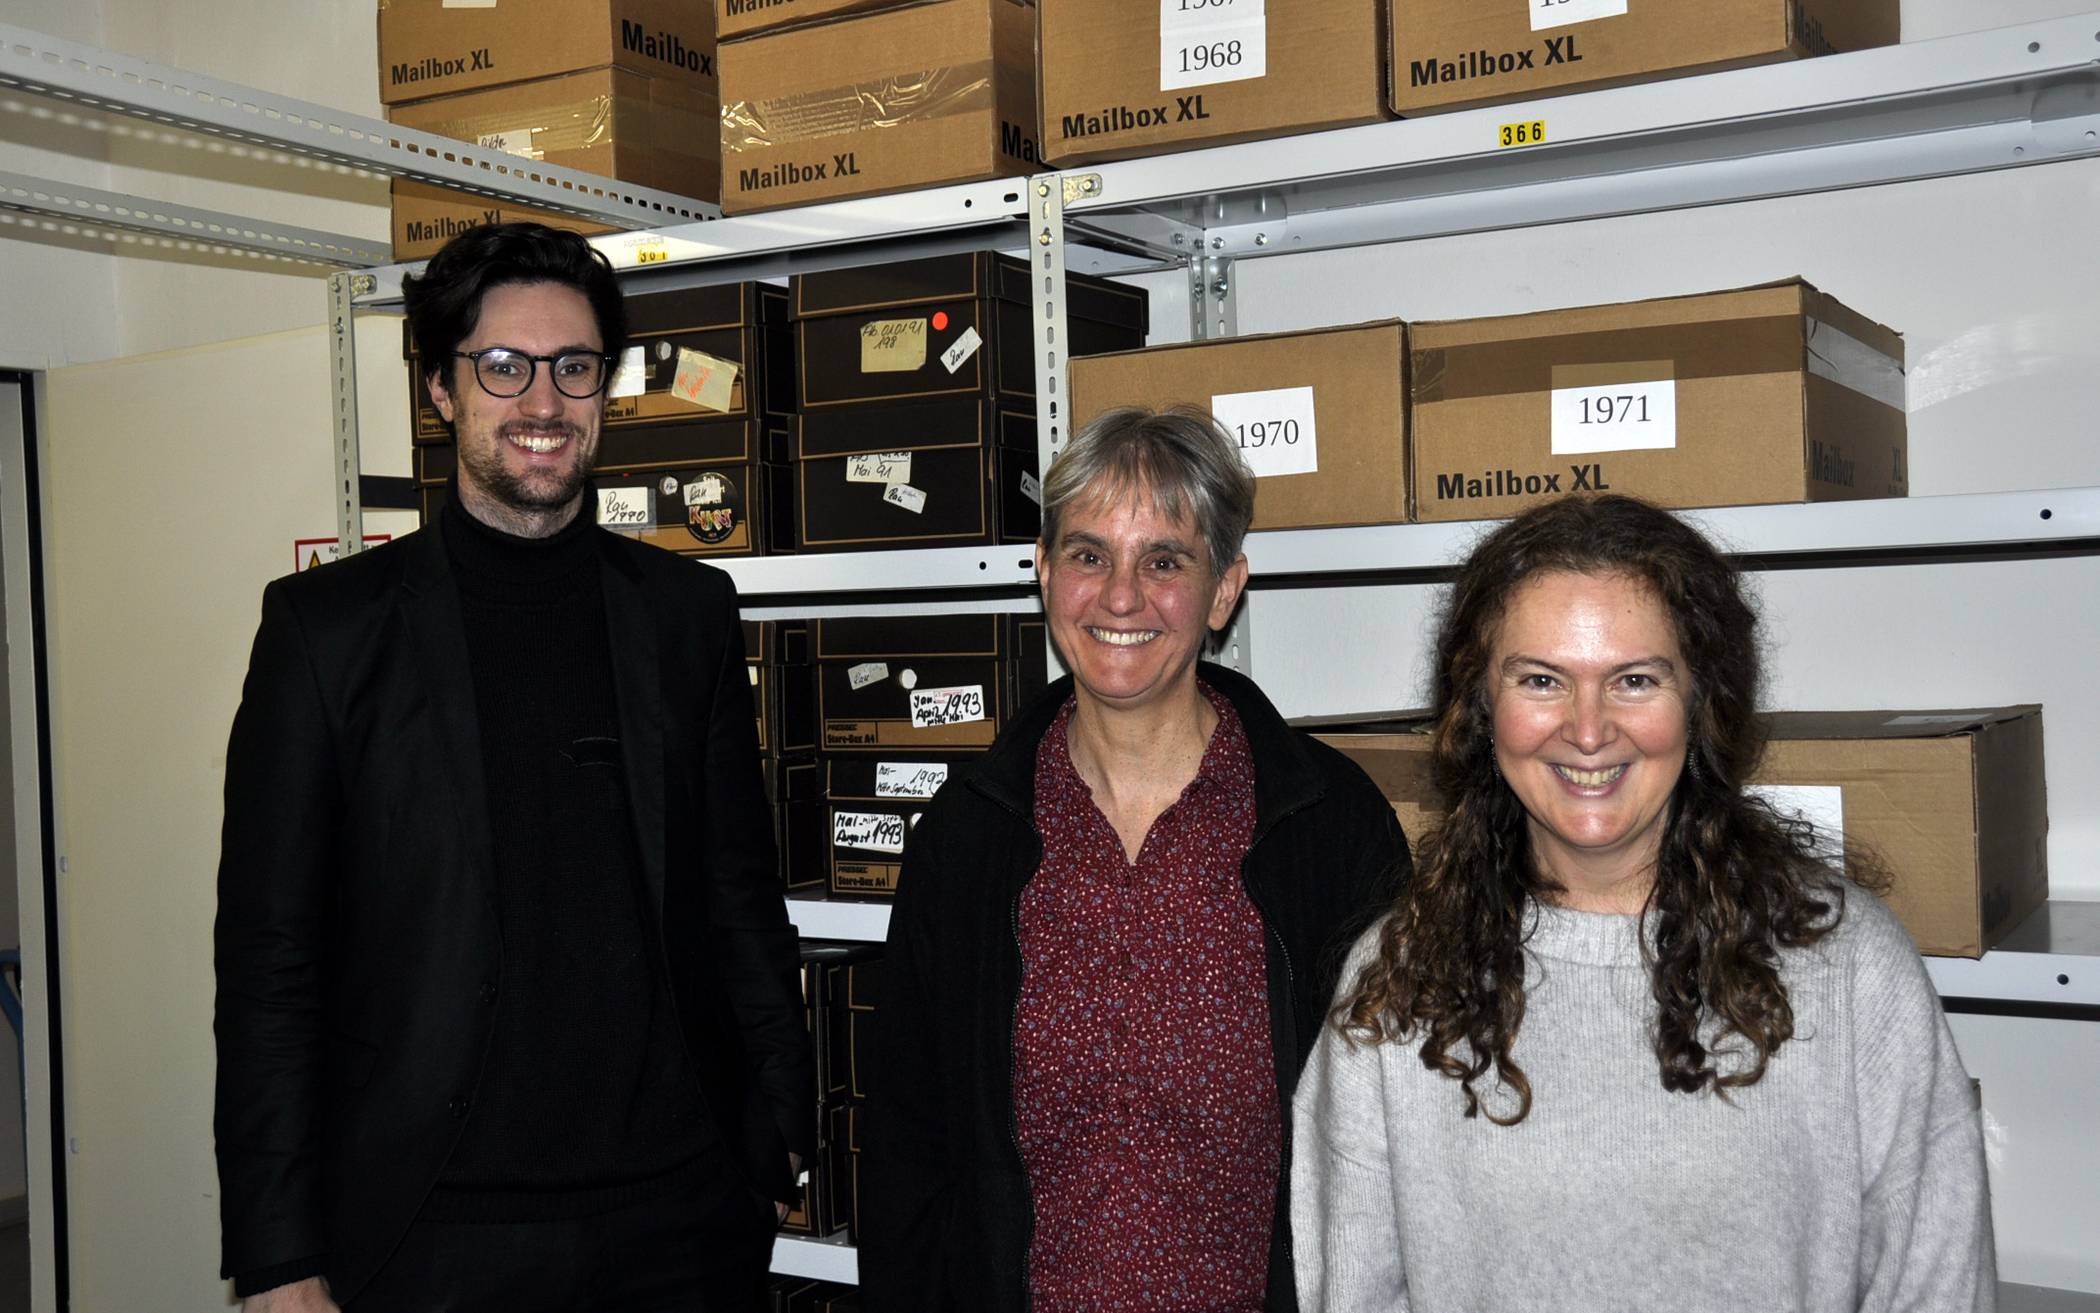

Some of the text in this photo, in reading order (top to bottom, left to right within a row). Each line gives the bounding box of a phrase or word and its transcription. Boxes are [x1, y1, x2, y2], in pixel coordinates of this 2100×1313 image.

[622, 18, 712, 77] Mailbox
[1178, 40, 1242, 72] 1968
[1410, 35, 1583, 87] Mailbox XL
[392, 48, 494, 85] Mailbox XL
[1062, 94, 1210, 138] Mailbox XL
[1503, 122, 1542, 146] 366
[740, 152, 860, 192] Mailbox XL
[407, 216, 478, 242] Mailbox
[1579, 395, 1652, 424] 1971
[1234, 419, 1299, 449] 1970
[1436, 463, 1610, 500] Mailbox XL
[1812, 439, 1856, 489] Mailbox
